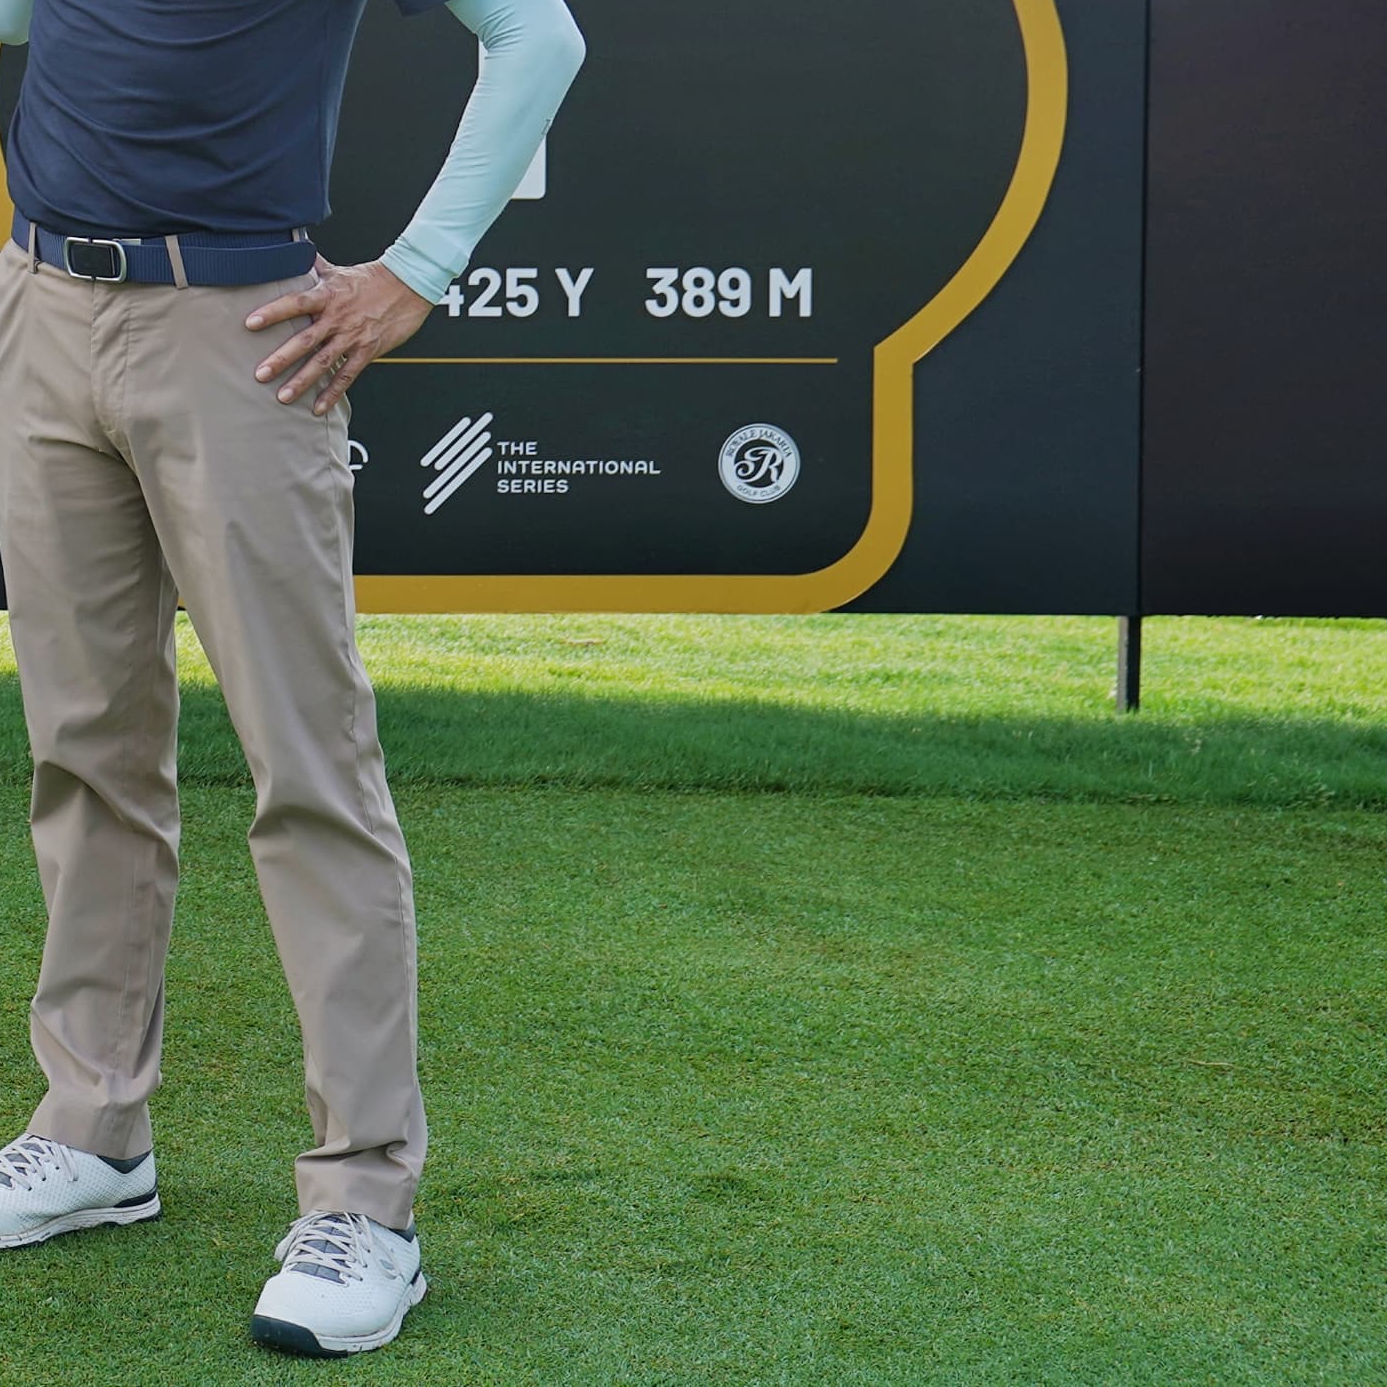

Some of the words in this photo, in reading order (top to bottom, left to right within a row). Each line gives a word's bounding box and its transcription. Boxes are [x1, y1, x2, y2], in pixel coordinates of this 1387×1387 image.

[554, 267, 594, 317] Y
[645, 267, 752, 318] 389
[768, 268, 813, 317] M
[497, 441, 538, 456] THE
[497, 459, 661, 475] INTERNATIONAL
[497, 478, 569, 494] SERIES
